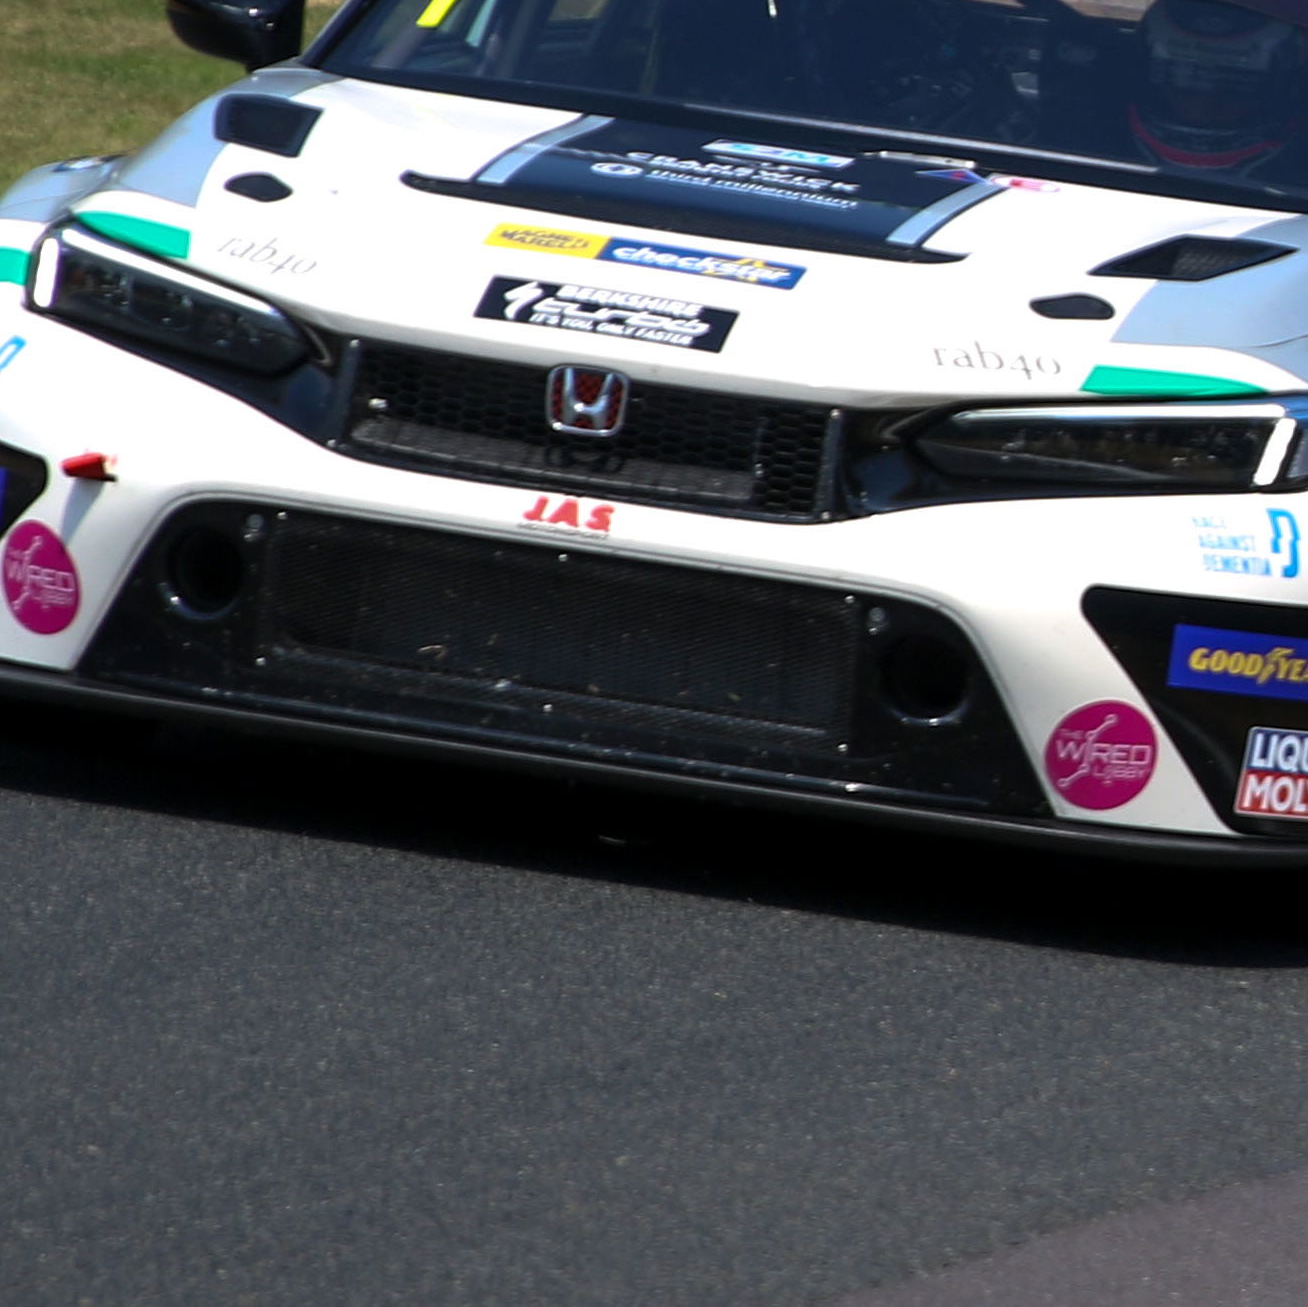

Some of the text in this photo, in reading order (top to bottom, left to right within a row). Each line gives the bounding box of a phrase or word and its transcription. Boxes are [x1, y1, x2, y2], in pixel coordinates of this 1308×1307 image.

[556, 284, 703, 320] BERKSHIRE
[932, 340, 1061, 380] rab40
[522, 495, 616, 532] JAS
[1055, 738, 1151, 765] WIRED
